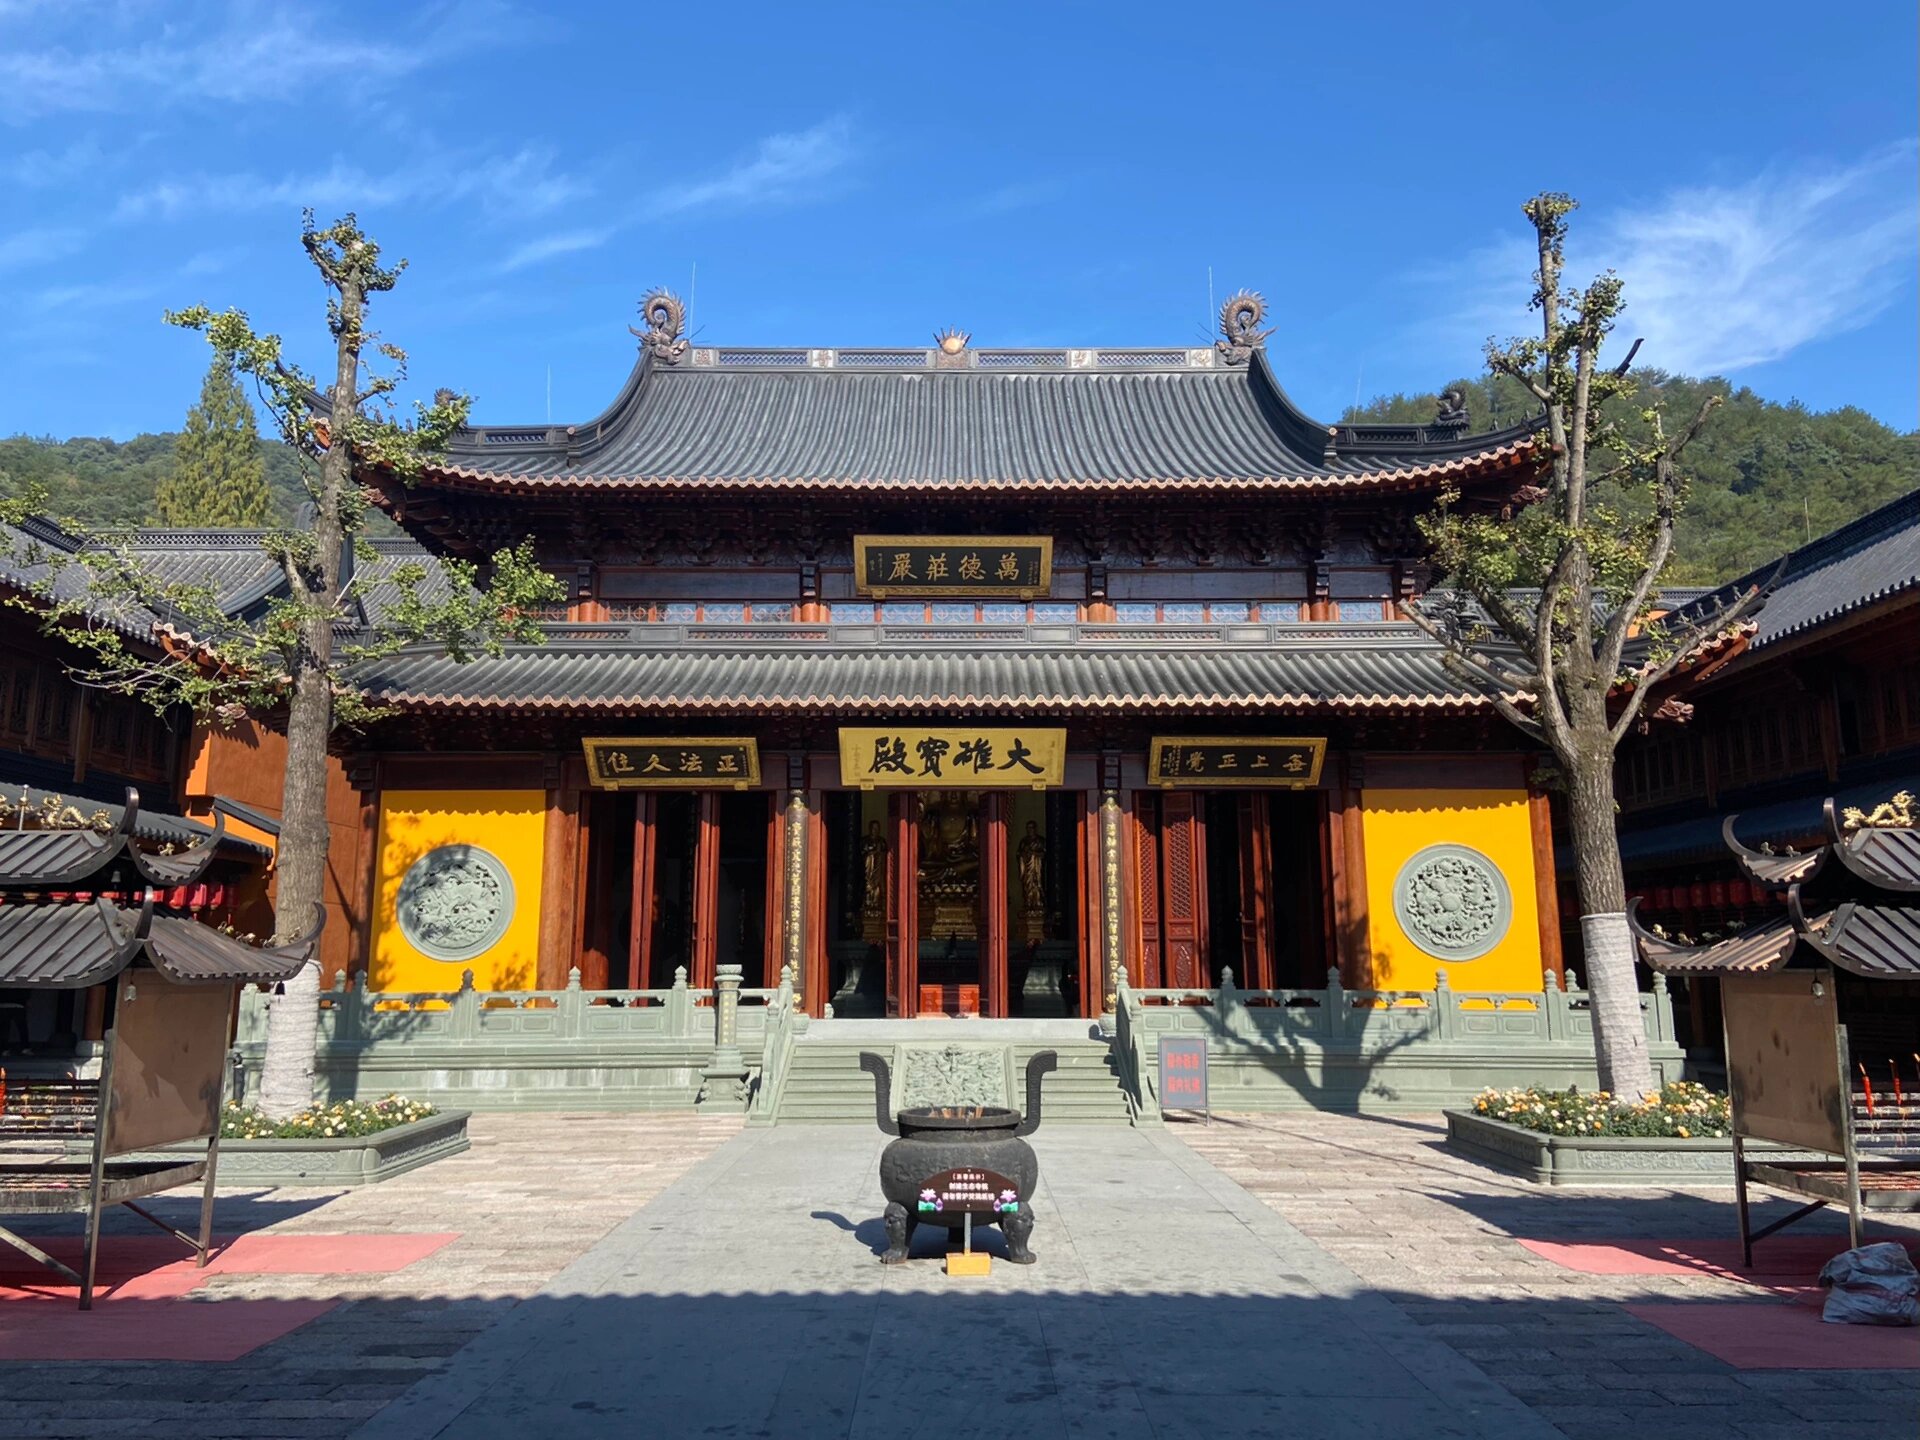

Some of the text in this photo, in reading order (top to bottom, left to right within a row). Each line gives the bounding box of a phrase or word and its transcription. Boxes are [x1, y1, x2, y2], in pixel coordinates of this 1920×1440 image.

[887, 551, 1020, 582] 萬德莊嚴
[606, 751, 739, 773] 正法久住
[868, 736, 1045, 778] 大雄寶殿
